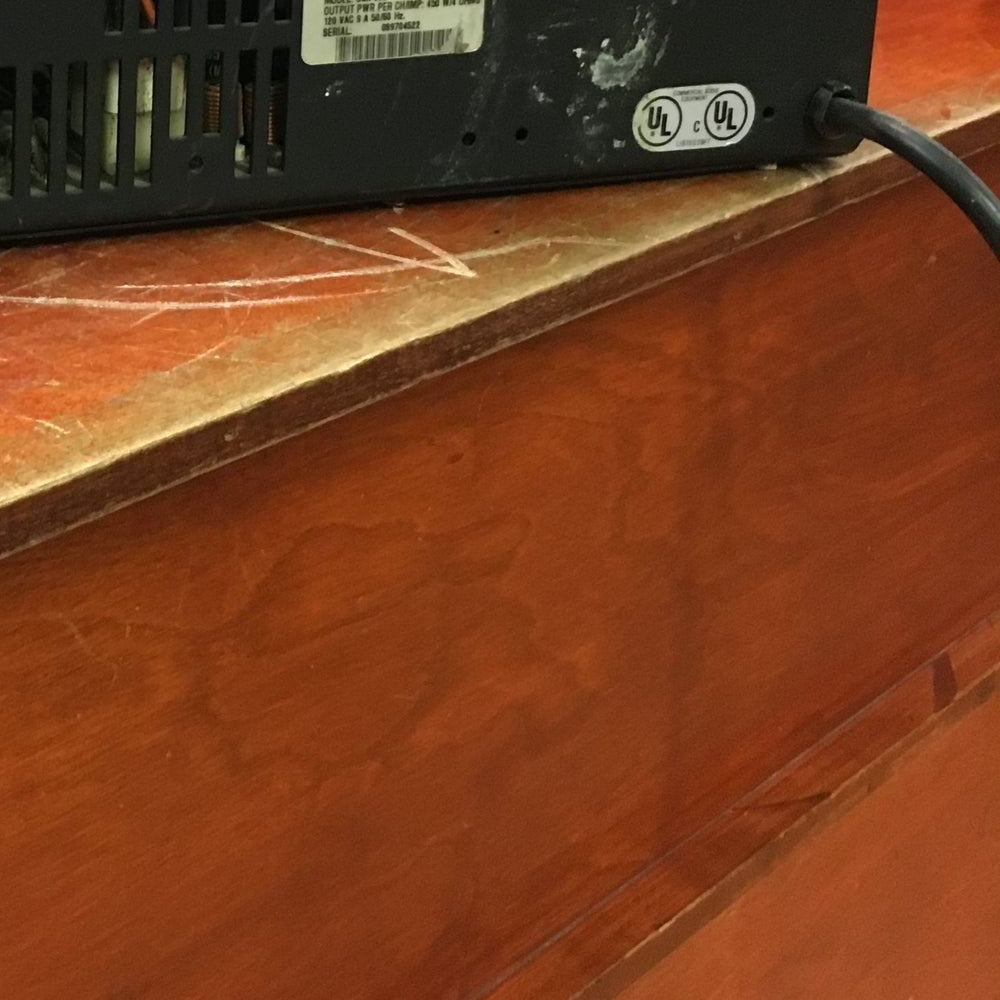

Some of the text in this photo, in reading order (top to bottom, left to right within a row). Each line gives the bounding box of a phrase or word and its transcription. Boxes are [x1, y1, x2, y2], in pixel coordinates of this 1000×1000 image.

[323, 4, 355, 16] OUTPUT
[357, 3, 375, 13] PWR
[377, 1, 393, 11] PER
[324, 17, 337, 25] 120
[339, 15, 354, 24] VAC
[363, 14, 369, 22] A
[647, 106, 671, 136] UL
[714, 100, 737, 130] UL
[693, 120, 701, 133] C
